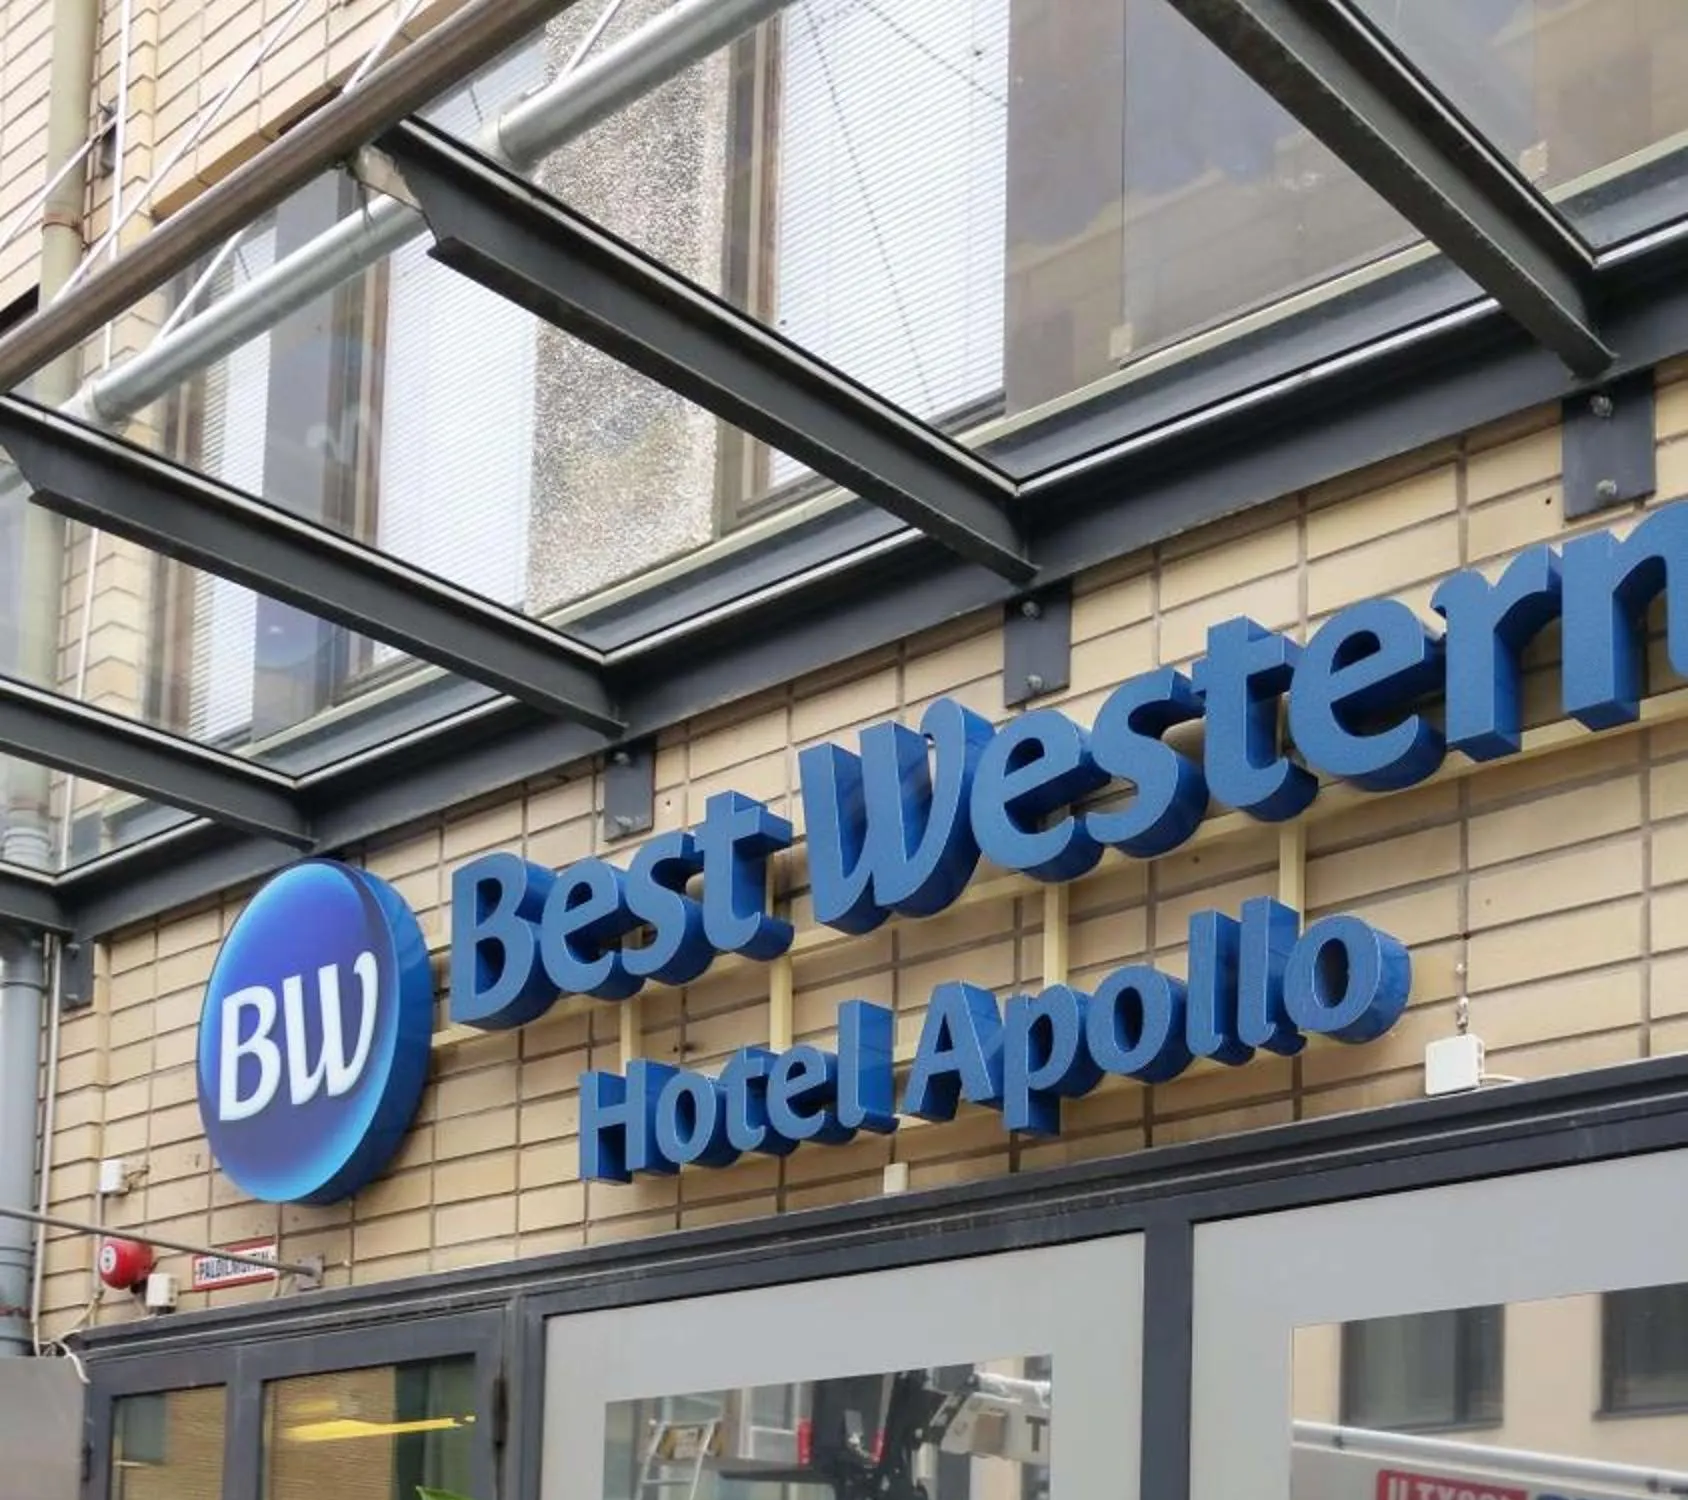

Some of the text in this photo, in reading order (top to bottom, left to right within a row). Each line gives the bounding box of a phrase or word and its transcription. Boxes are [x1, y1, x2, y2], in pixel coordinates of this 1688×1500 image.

[450, 500, 1688, 1030] Best Western
[218, 951, 379, 1121] BW
[579, 895, 1411, 1185] Hotel Apollo
